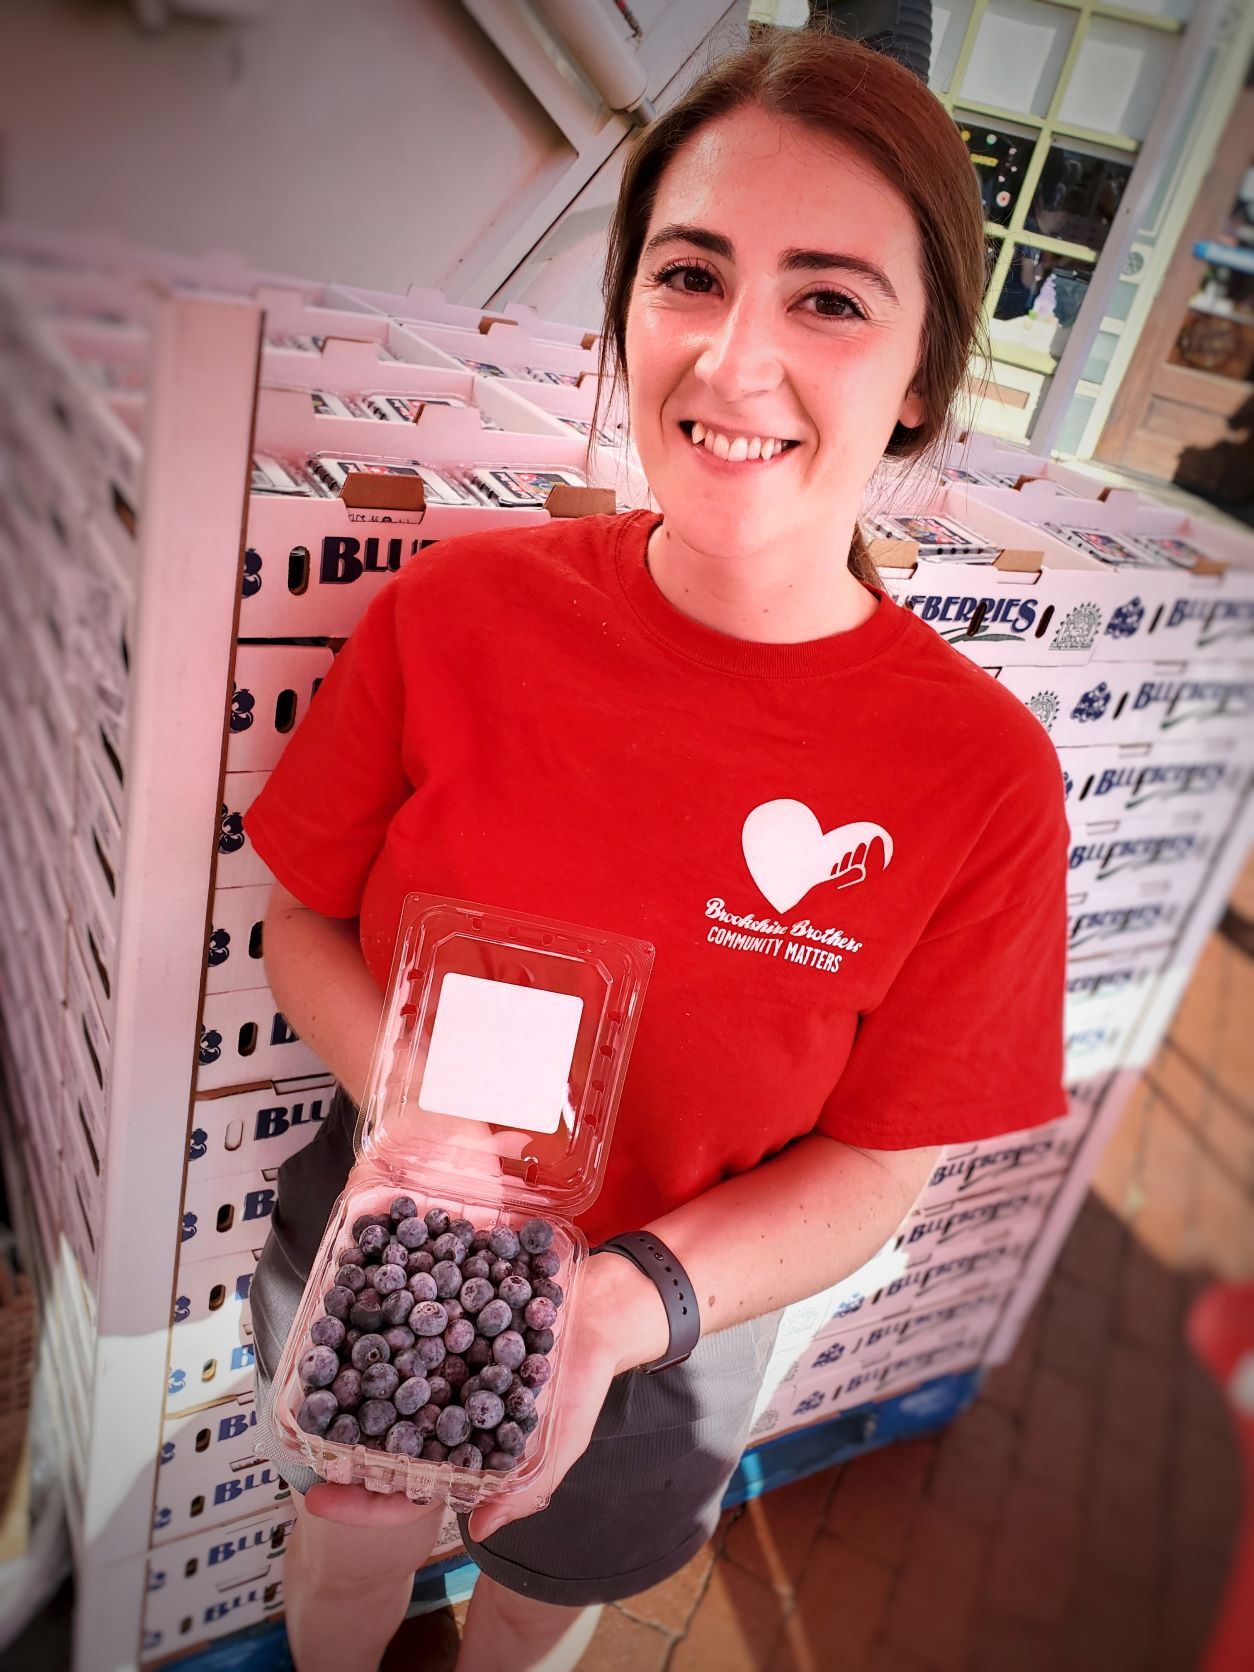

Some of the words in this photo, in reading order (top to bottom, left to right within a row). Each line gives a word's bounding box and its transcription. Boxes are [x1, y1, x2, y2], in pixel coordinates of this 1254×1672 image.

[319, 536, 440, 584] BLU
[705, 897, 788, 935] Brookshire
[790, 920, 863, 952] Brothers
[707, 926, 784, 957] COMMUNITY
[784, 941, 843, 973] MATTERS
